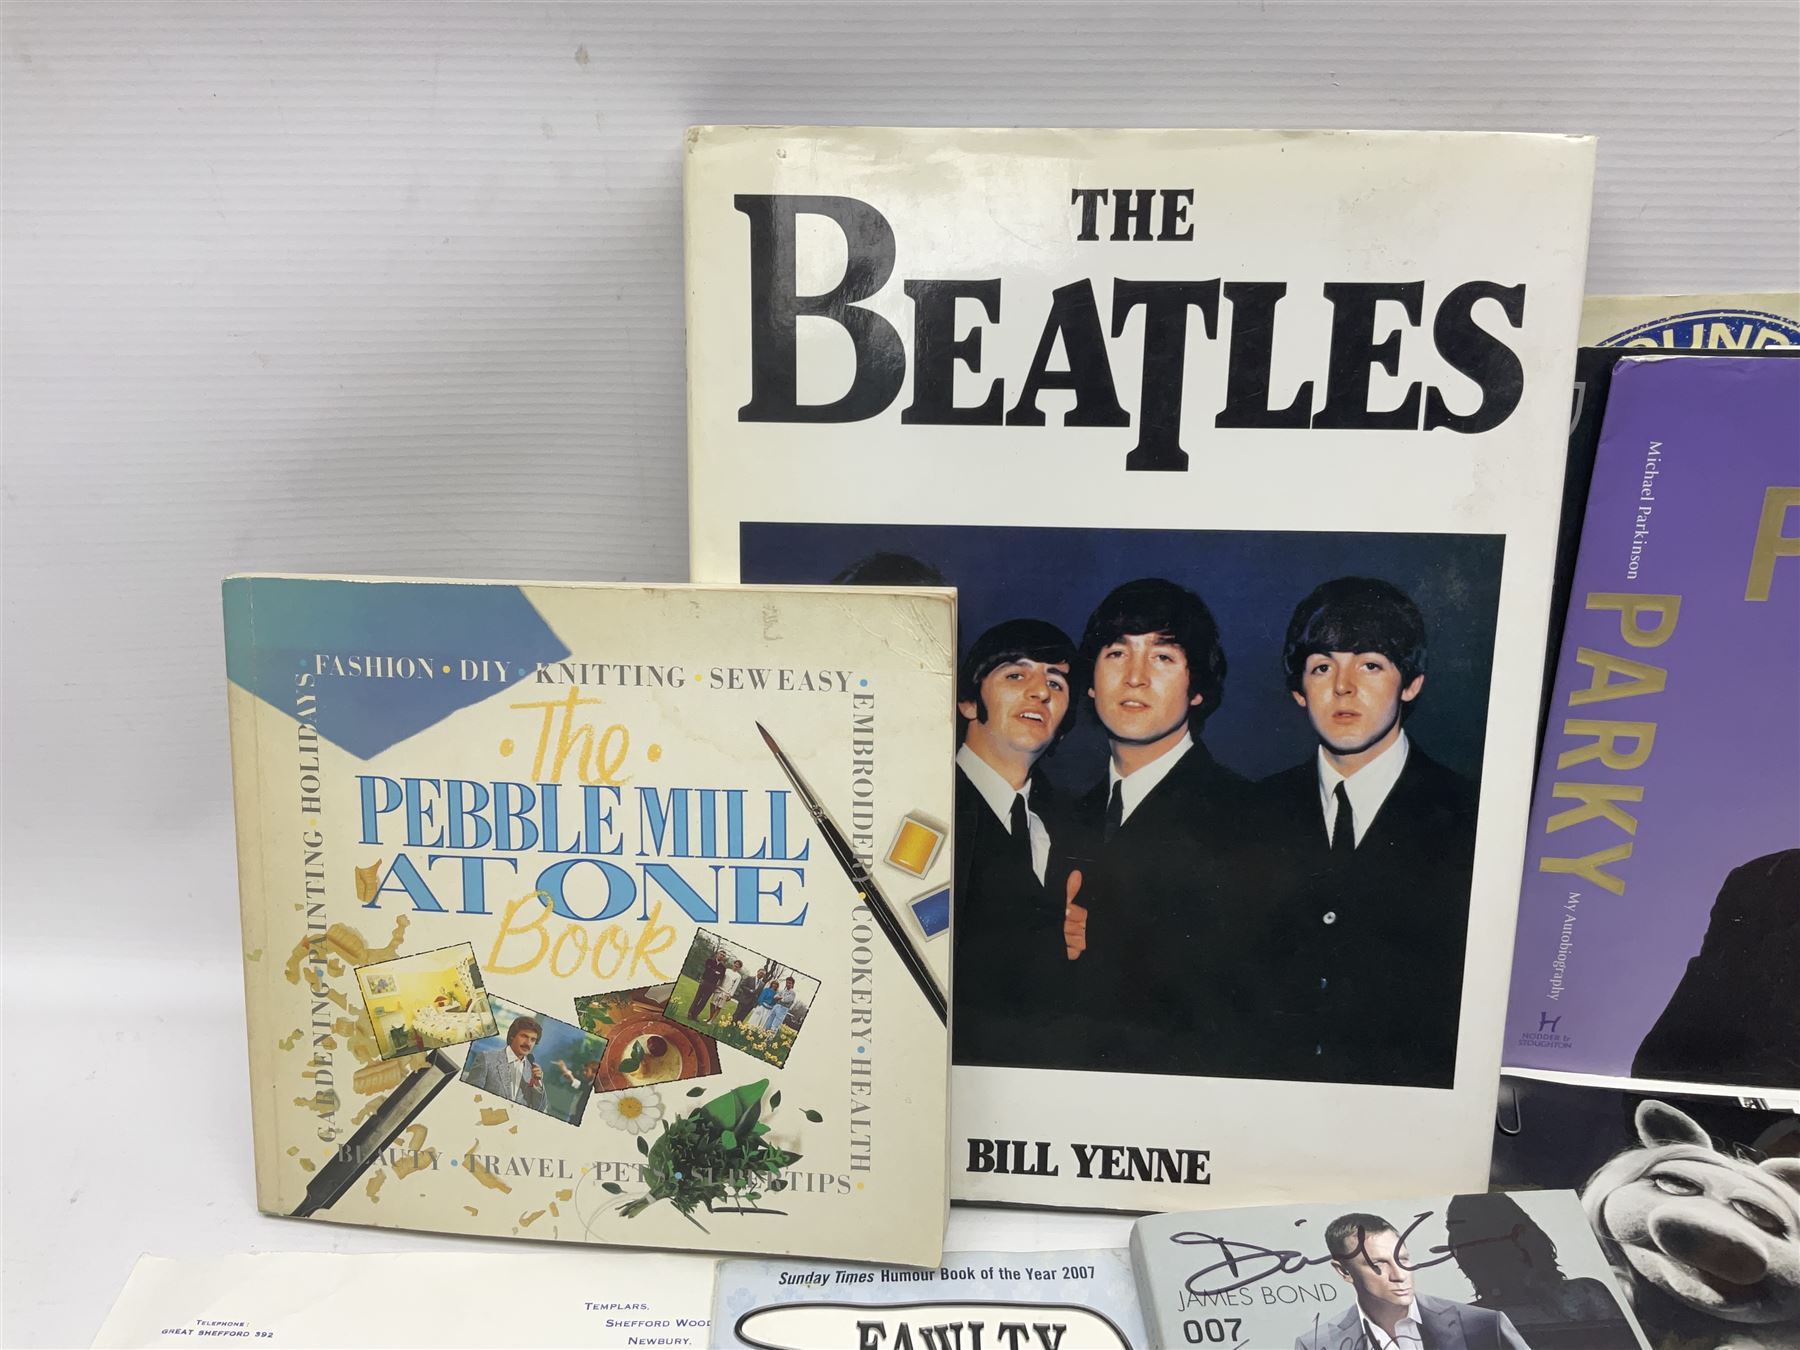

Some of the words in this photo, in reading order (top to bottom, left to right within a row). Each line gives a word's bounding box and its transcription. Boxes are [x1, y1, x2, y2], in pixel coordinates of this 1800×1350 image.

[1072, 188, 1195, 242] THE
[734, 193, 1526, 472] BEATLES
[1640, 441, 1663, 501] Michael
[1627, 506, 1652, 579] Parkinson
[314, 654, 434, 680] FASHION
[460, 659, 511, 682] DIY
[535, 663, 685, 688] KNITTING
[296, 672, 321, 815] HOLIDAYS
[510, 686, 633, 786] The
[1539, 592, 1682, 896] PARKY
[354, 774, 624, 855] PEBBLE
[634, 786, 809, 861] MILL
[303, 831, 327, 961] PAINTING
[361, 853, 518, 915] AT
[536, 858, 809, 926] ONE
[1564, 891, 1581, 912] My
[482, 890, 678, 980] Book
[851, 905, 873, 1044] COOKERY
[1550, 914, 1577, 1001] Autobiography
[310, 982, 337, 1142] GARDENING
[850, 1057, 872, 1172] HEALTH
[465, 1153, 573, 1179] TRAVEL
[966, 1138, 1059, 1177] BILL
[1070, 1143, 1211, 1185] YENNE
[778, 1271, 830, 1286] Sunday
[835, 1270, 874, 1284] Times
[881, 1269, 935, 1282] Humour
[941, 1267, 976, 1280] Book
[981, 1266, 994, 1280] of
[999, 1267, 1020, 1280] the
[1025, 1268, 1057, 1280] Year
[1063, 1266, 1095, 1279] 2007
[1177, 1287, 1253, 1312] JAMES
[1261, 1283, 1337, 1305] BOND
[1183, 1318, 1242, 1344] 007
